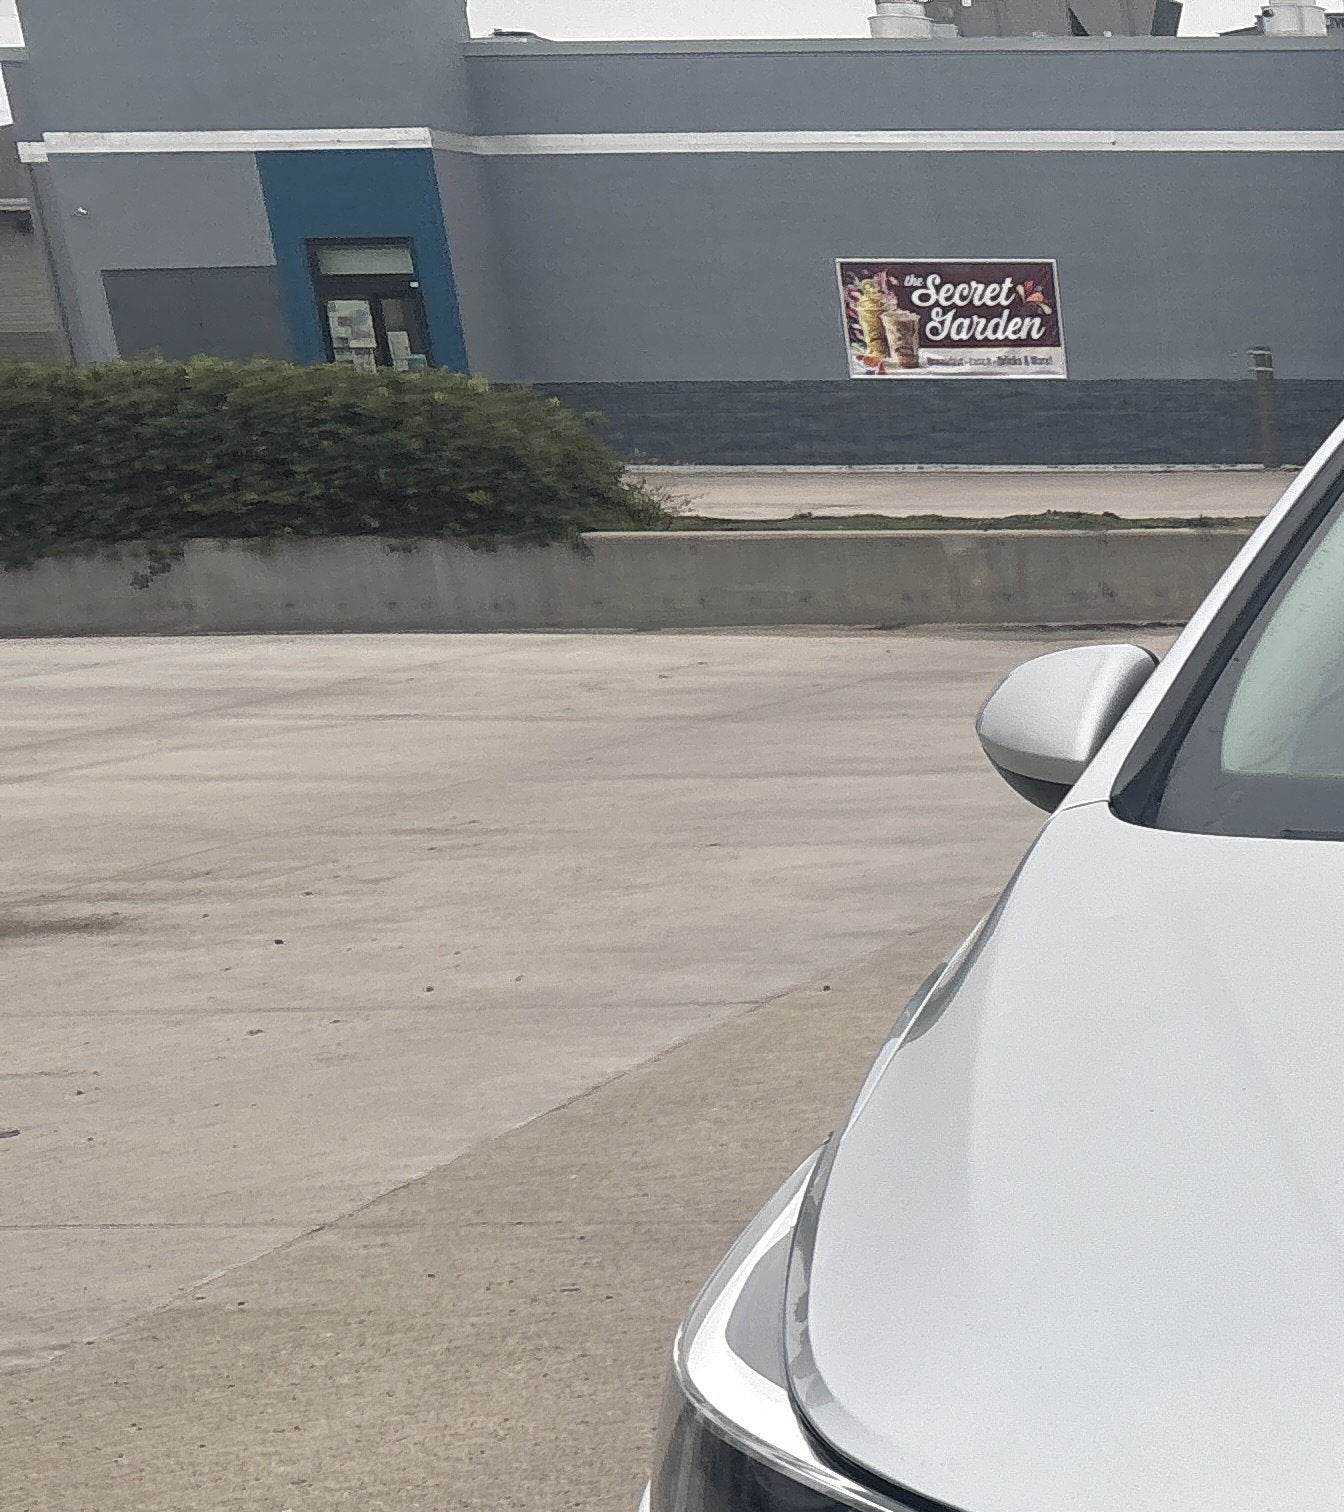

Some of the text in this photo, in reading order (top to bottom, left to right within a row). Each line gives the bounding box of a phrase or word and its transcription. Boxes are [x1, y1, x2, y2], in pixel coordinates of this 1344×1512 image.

[904, 273, 924, 287] the
[911, 273, 1016, 307] Secret
[925, 307, 1046, 341] Garden
